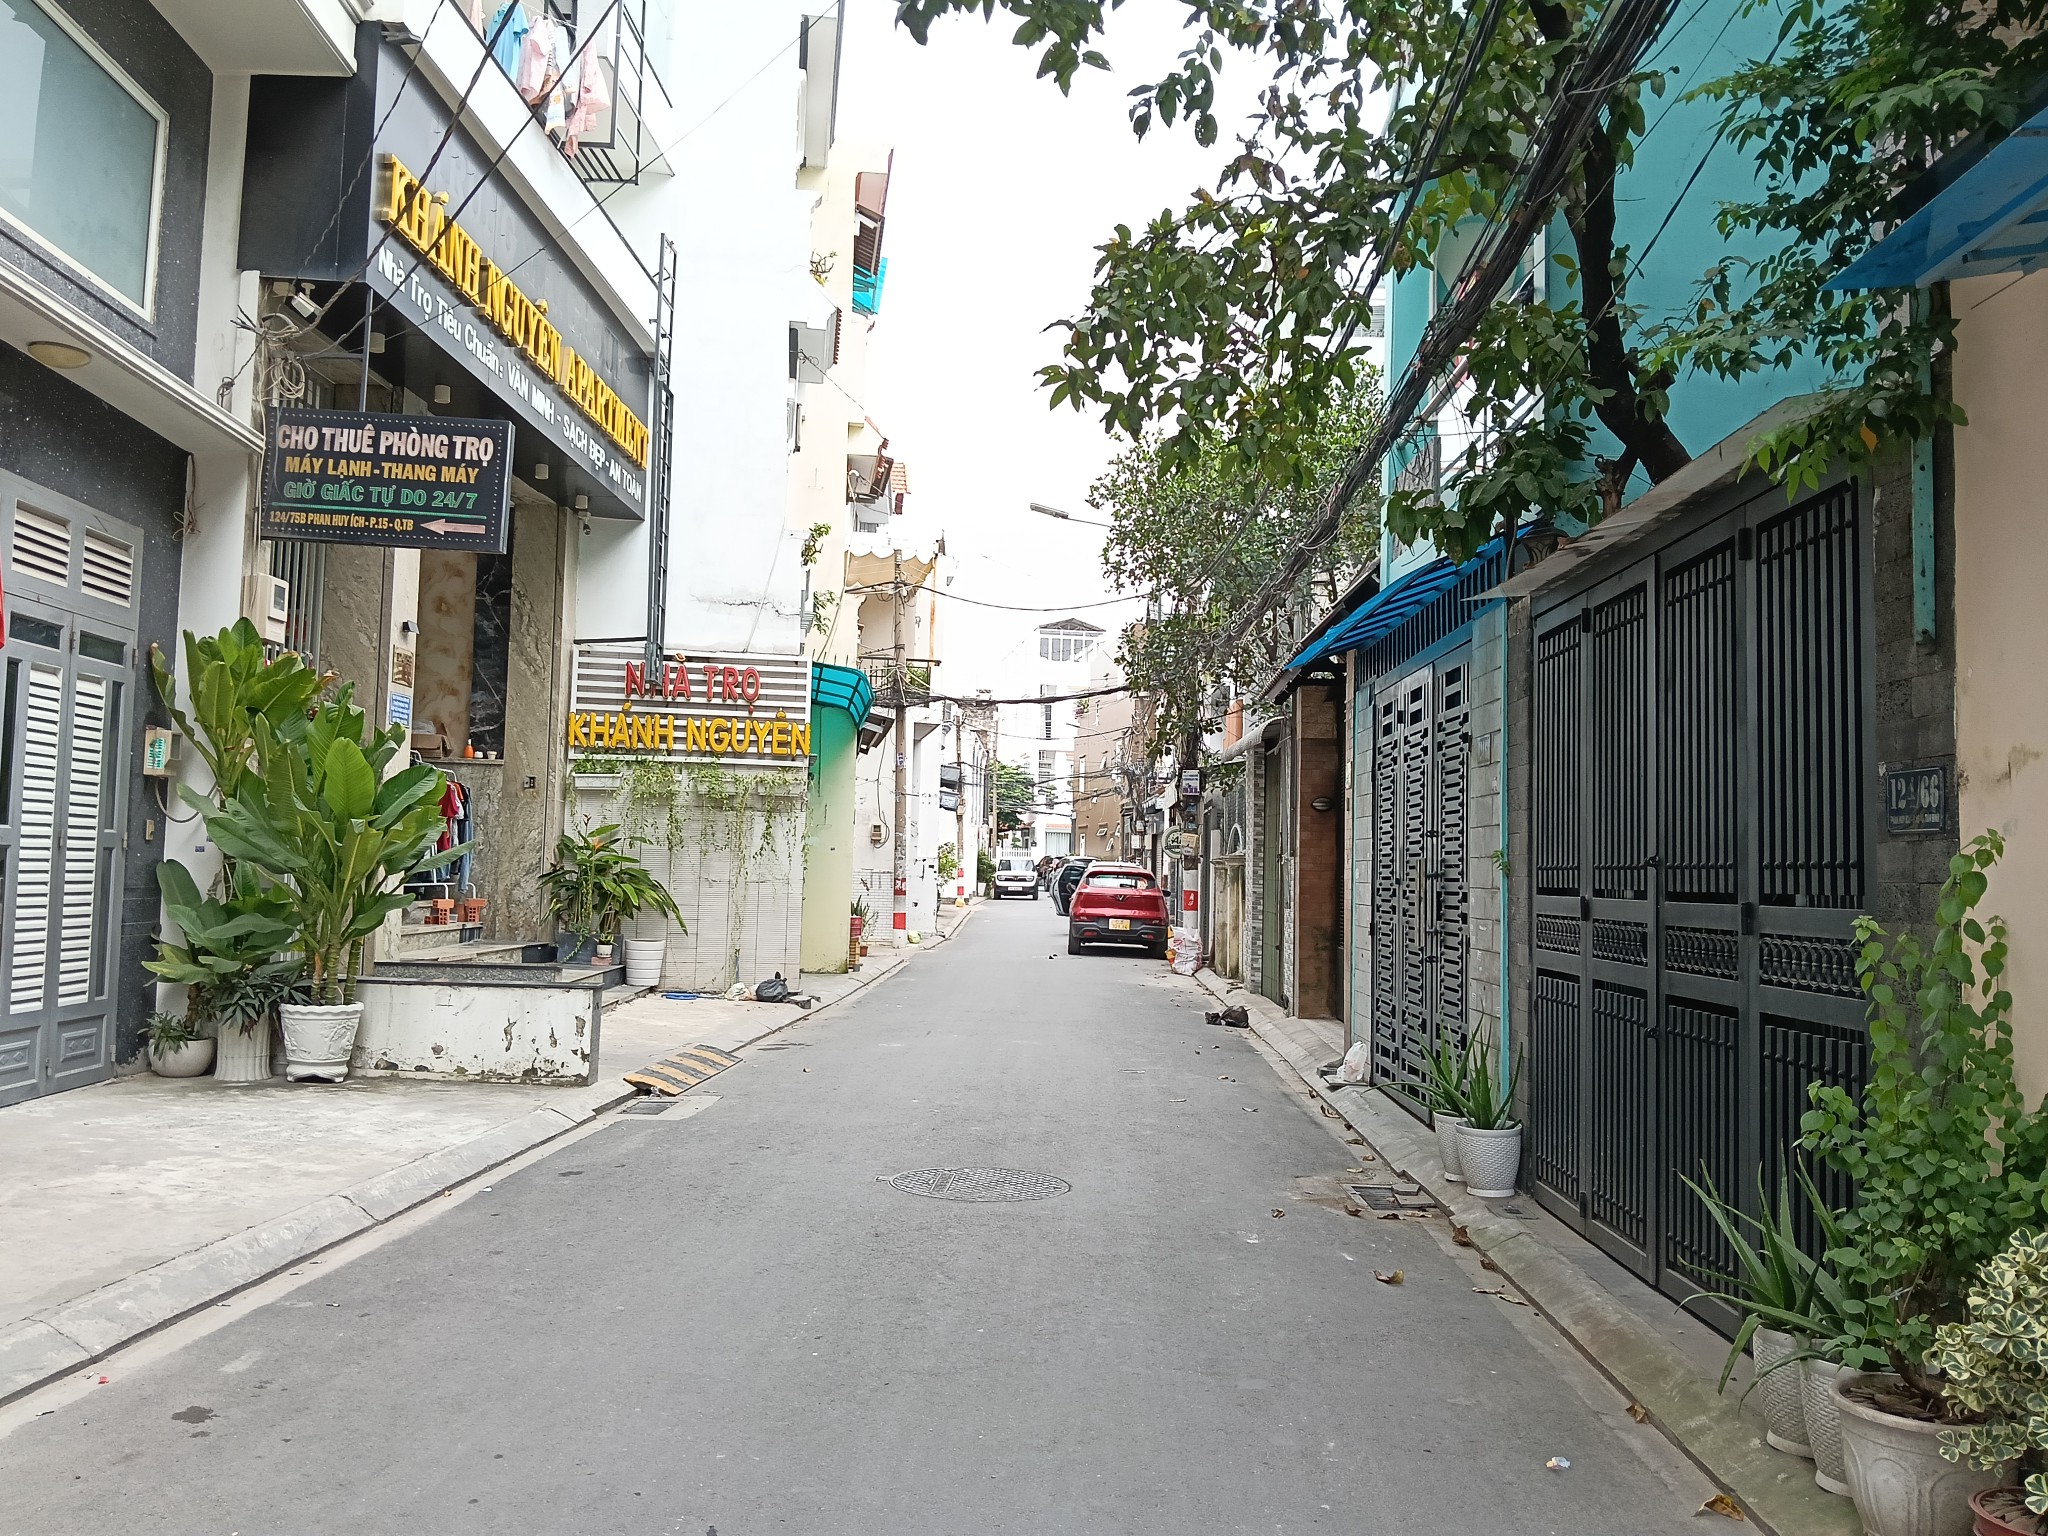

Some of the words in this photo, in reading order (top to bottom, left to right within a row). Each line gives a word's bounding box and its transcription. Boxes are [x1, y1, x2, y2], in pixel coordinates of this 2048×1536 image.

[378, 246, 406, 293] Nhà
[410, 273, 432, 320] Trọ
[507, 360, 528, 402] VĂN
[531, 384, 554, 425] MINH
[563, 414, 588, 454] SẠCH
[589, 438, 606, 470] ĐẸP
[609, 459, 621, 485] AN
[622, 469, 642, 503] TOÀN
[564, 347, 649, 470] APARTMENT
[278, 424, 318, 450] CHO
[322, 423, 376, 454] THUÊ
[379, 426, 449, 459] PHÒNG
[452, 435, 494, 467] TRỌ
[285, 453, 324, 474] MÁY
[327, 459, 372, 479] LẠNH
[382, 462, 436, 481] THANG
[441, 463, 479, 484] MÁY
[283, 478, 317, 498] GIỜ
[321, 478, 364, 501] GIẤC
[369, 485, 396, 507] TỰ
[400, 489, 427, 506] DO
[432, 490, 478, 510] 24/7
[269, 511, 306, 524] 124/75B
[307, 513, 331, 526] PHAN
[332, 514, 349, 527] HUY
[350, 513, 365, 527] ÍCH
[370, 518, 388, 529] P.15
[394, 518, 414, 531] Q.TB
[703, 665, 761, 715] TRỌ
[568, 701, 675, 751] KHÁNH
[686, 708, 811, 757] NGUYÊN
